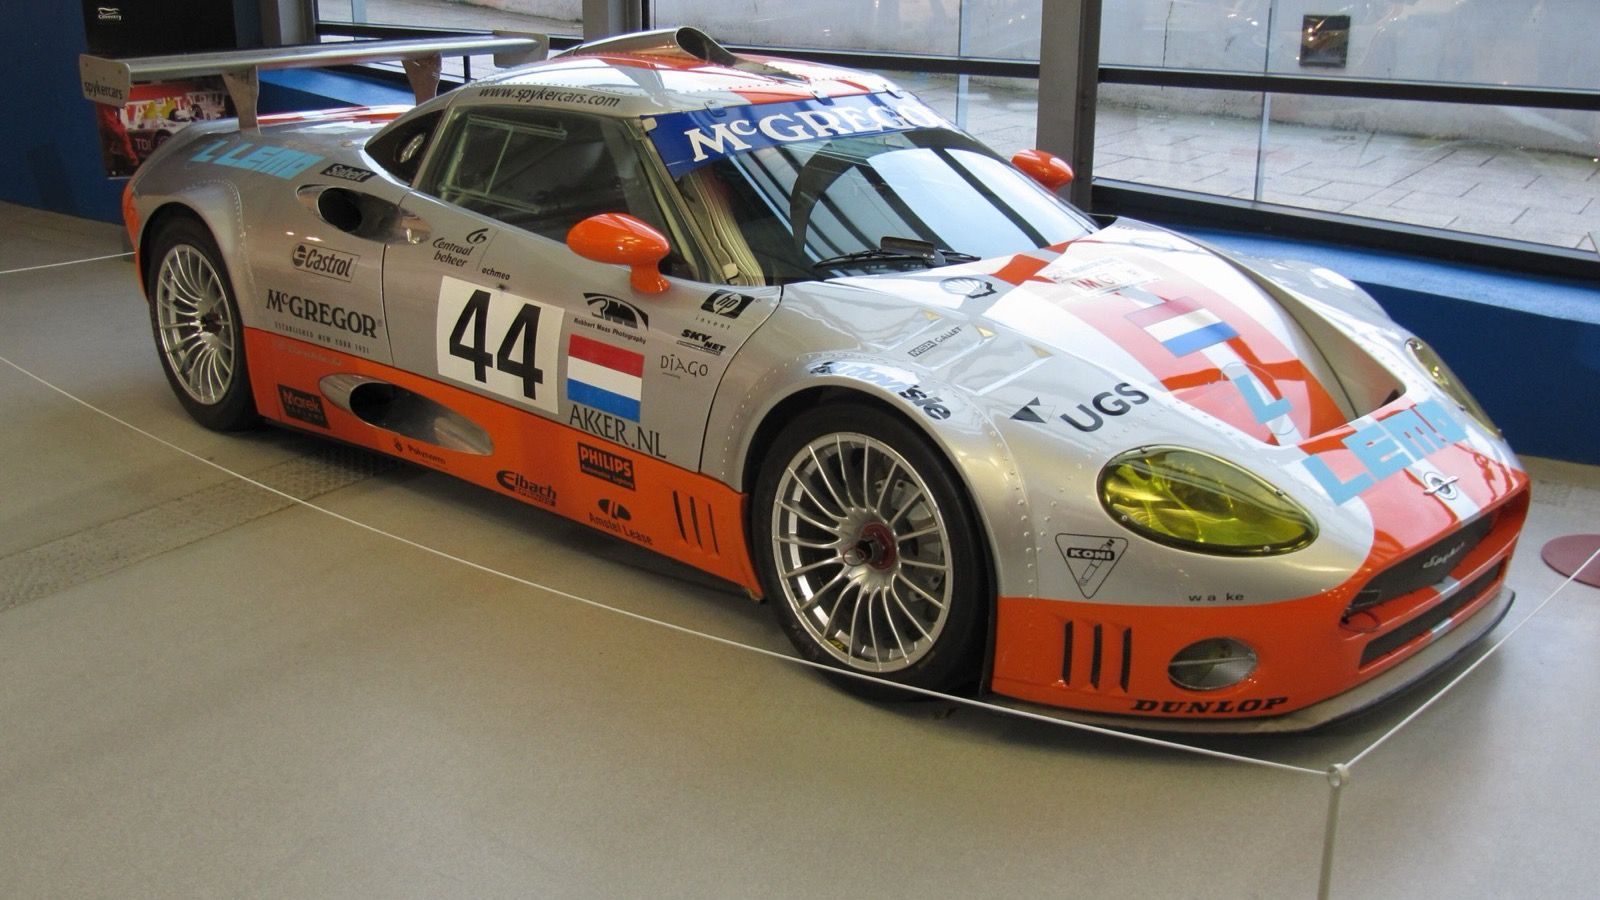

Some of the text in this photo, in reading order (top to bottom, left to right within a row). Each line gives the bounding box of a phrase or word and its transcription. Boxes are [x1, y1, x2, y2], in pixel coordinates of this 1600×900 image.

[84, 80, 123, 99] spykercars
[479, 87, 620, 107] www.spykercars.com
[432, 238, 474, 257] Centraal
[305, 251, 354, 278] Castrol
[433, 251, 468, 268] beheer
[482, 267, 511, 281] achmea
[266, 289, 377, 339] McGREGOR
[449, 288, 544, 401] 44
[612, 328, 647, 345] Photography
[1059, 382, 1150, 433] UGS
[569, 404, 667, 458] AKKER.NL
[580, 446, 632, 477] PHILIPS
[496, 470, 556, 499] Eibach
[1069, 549, 1111, 560] KONI
[1131, 697, 1288, 717] DUNLOP
